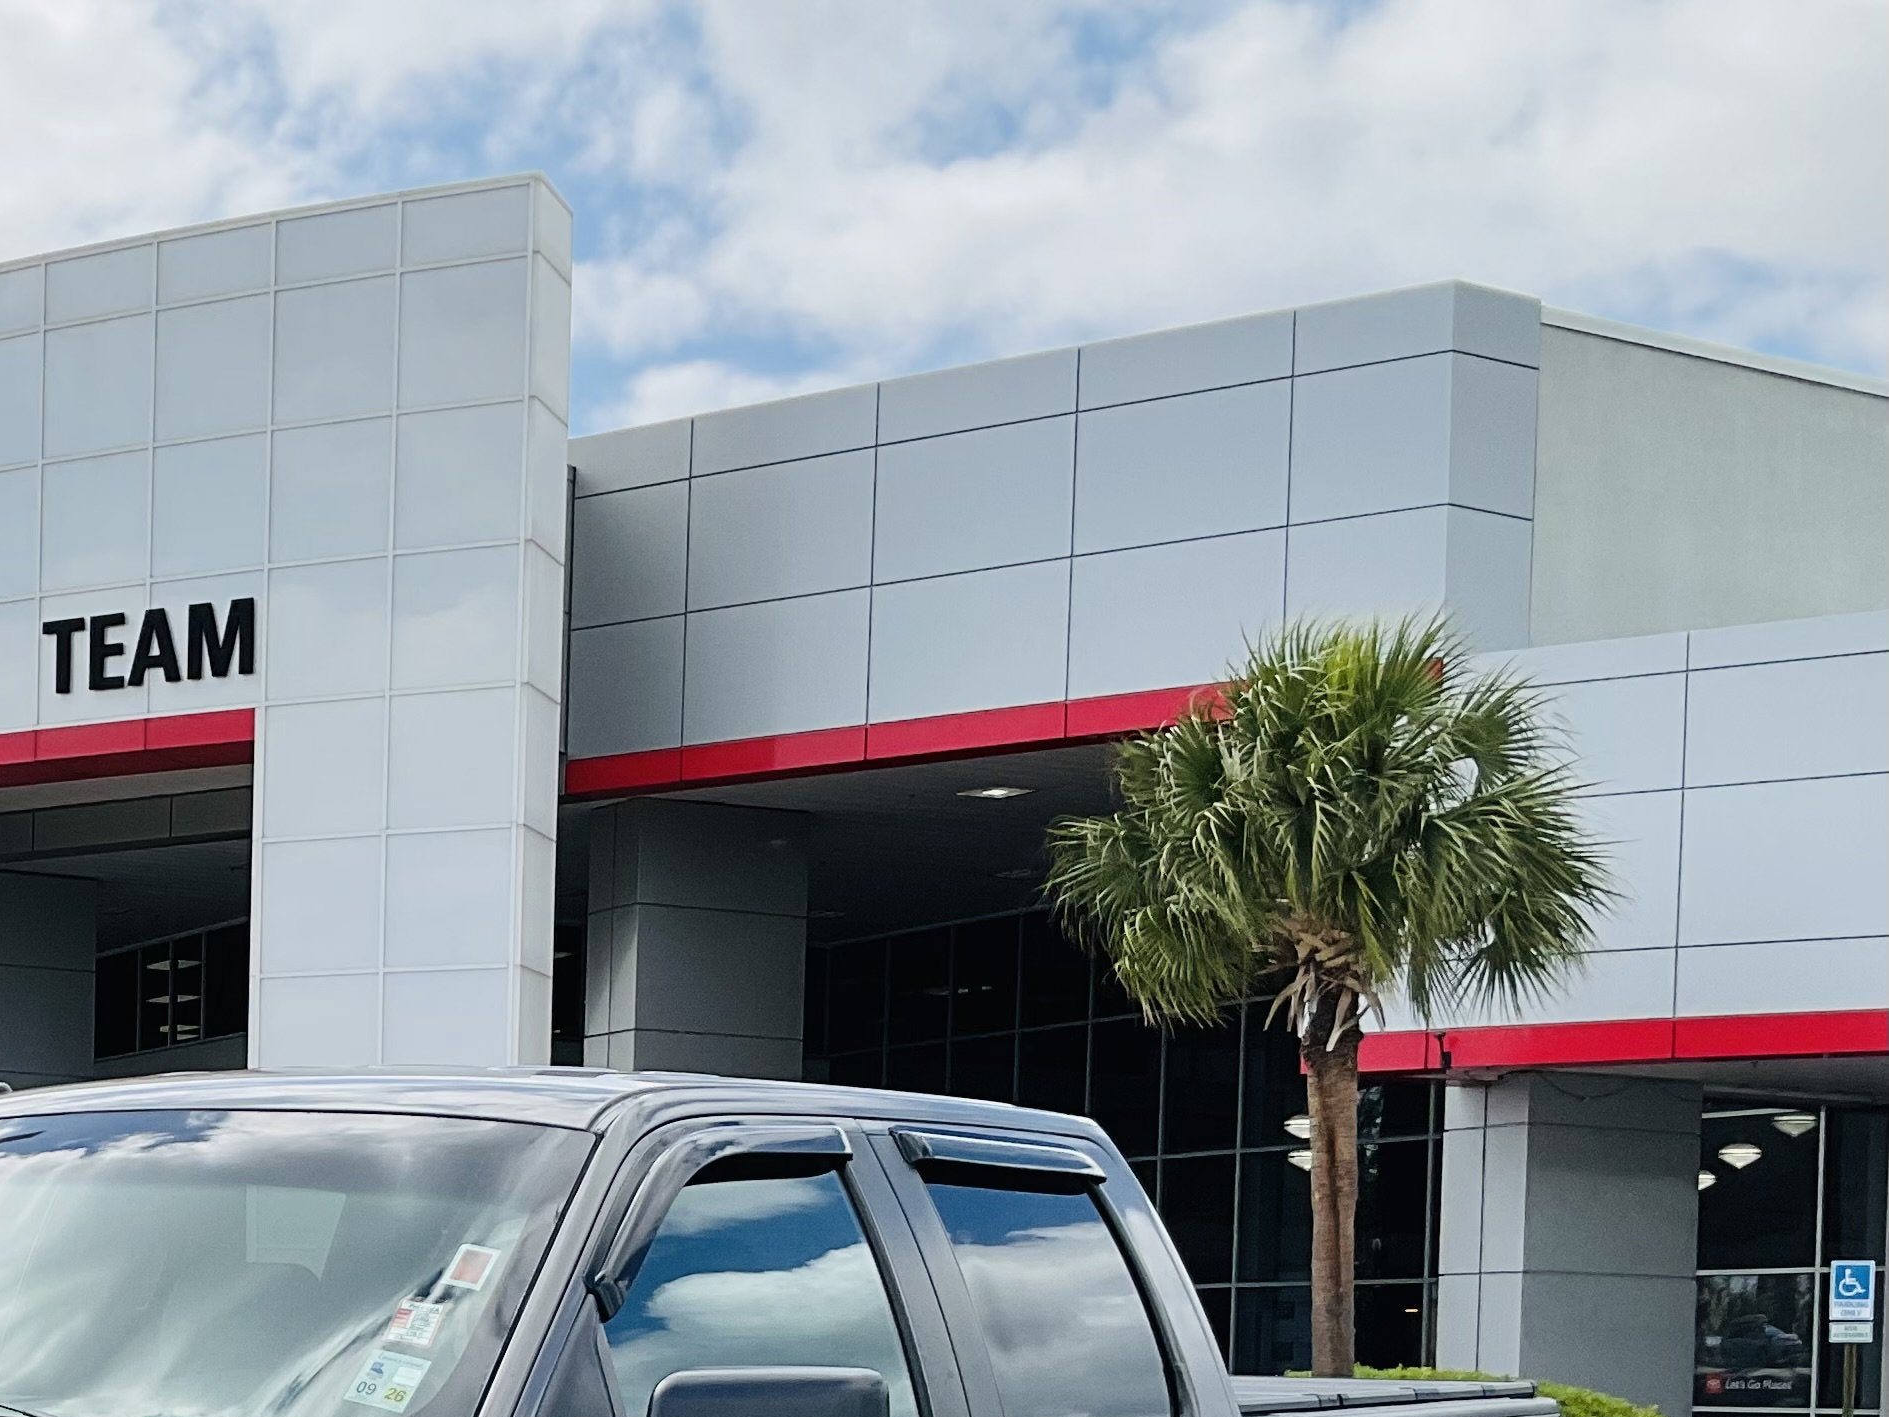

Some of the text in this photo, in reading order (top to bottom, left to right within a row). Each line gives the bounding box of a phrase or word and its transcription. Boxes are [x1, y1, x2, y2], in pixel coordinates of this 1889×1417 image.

[43, 597, 254, 695] TEAM
[356, 1381, 407, 1402] 09 26
